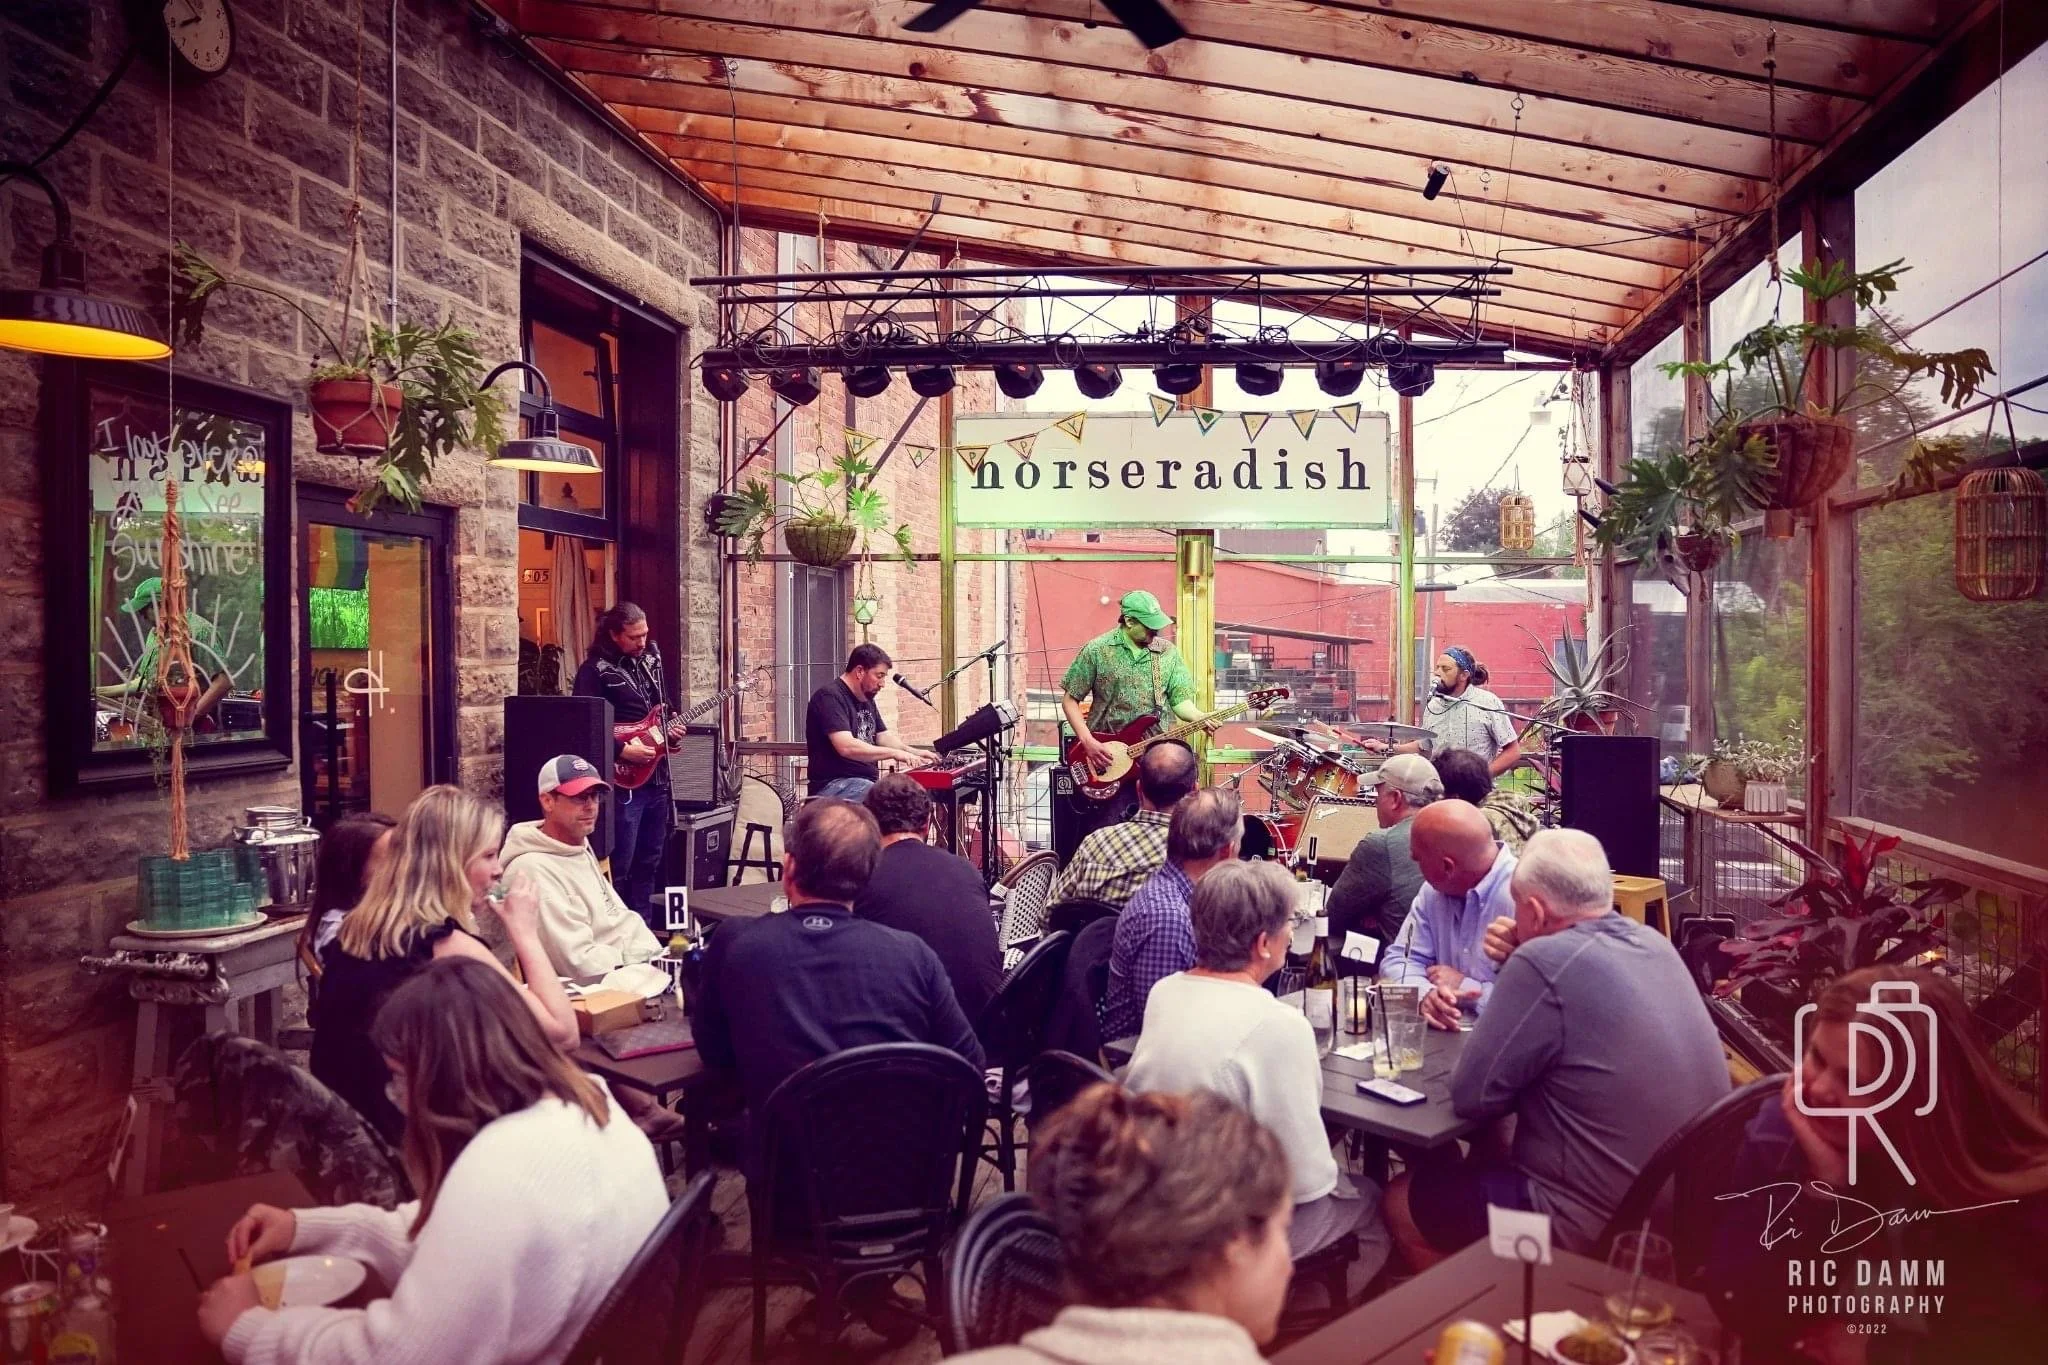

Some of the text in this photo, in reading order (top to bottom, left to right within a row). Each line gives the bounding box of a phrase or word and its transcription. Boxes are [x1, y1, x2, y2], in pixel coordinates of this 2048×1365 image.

[971, 447, 1371, 491] horseradish
[111, 532, 254, 582] Sushine!
[668, 892, 685, 925] R
